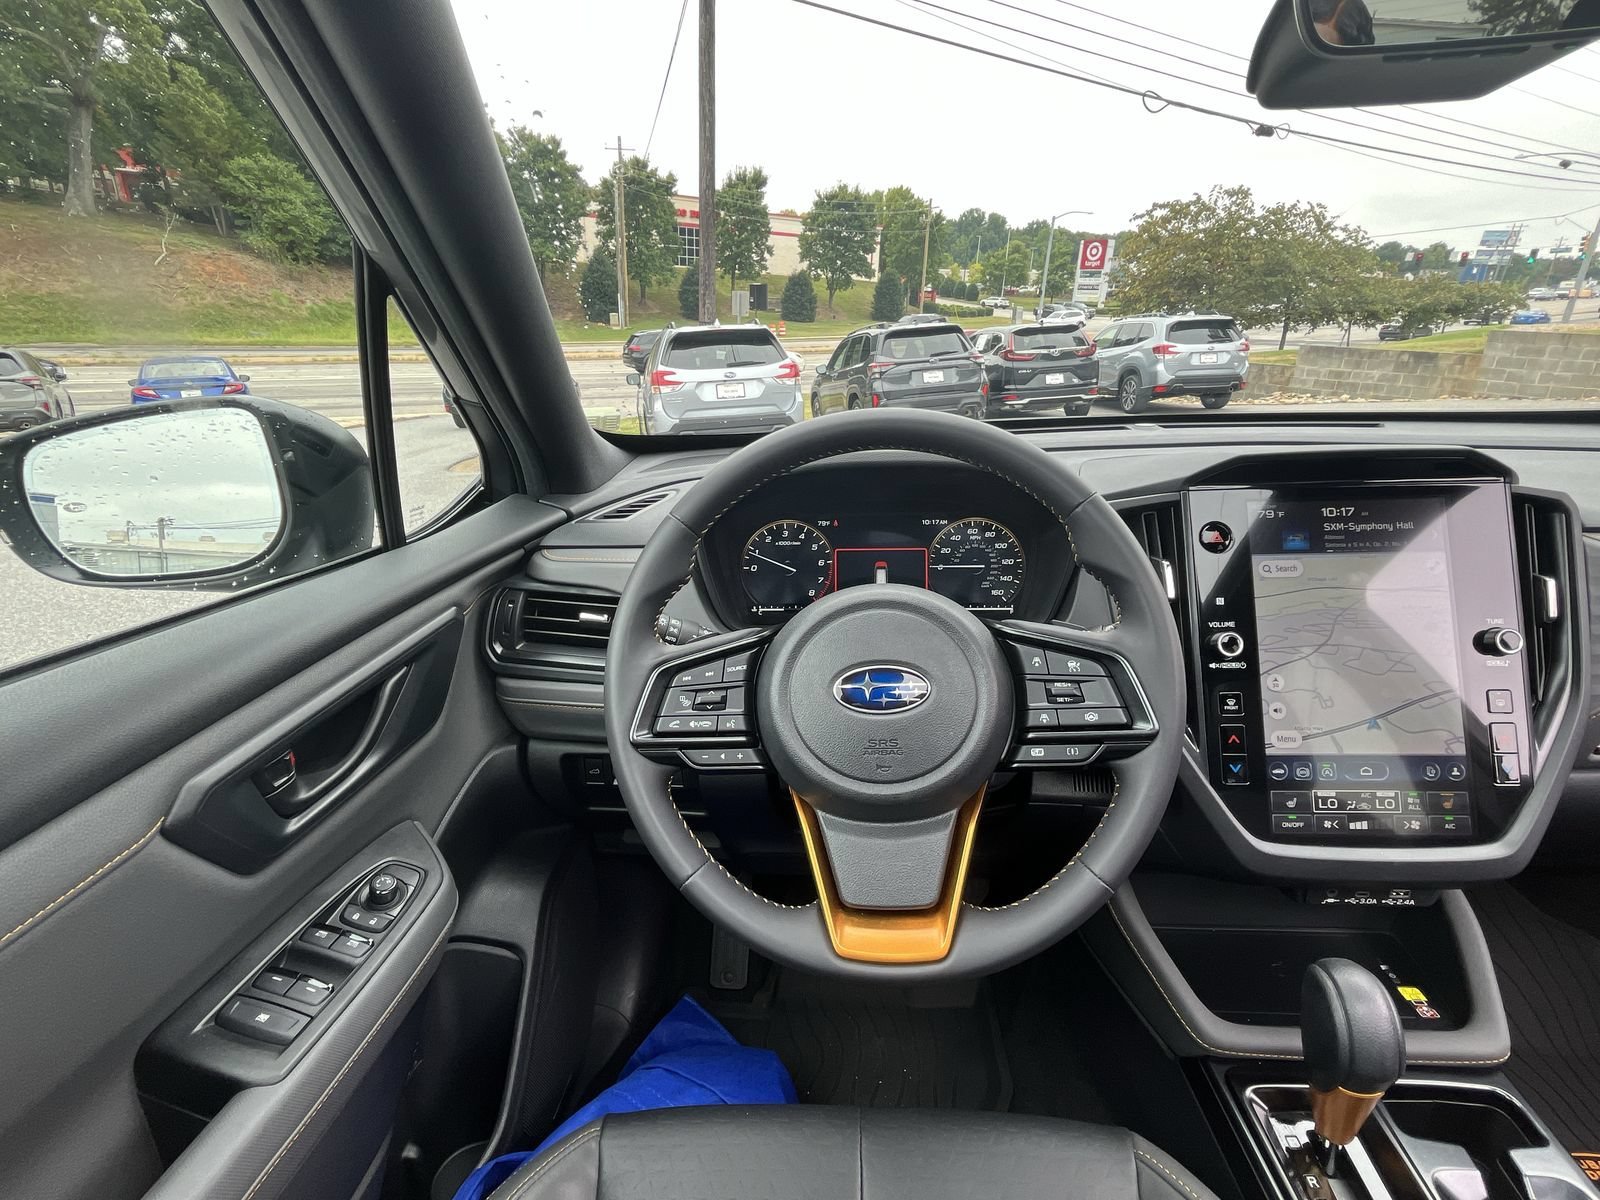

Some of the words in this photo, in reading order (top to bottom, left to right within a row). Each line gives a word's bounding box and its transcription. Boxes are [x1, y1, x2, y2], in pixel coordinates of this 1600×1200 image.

[1320, 507, 1355, 517] 10:17
[1323, 522, 1394, 532] SXM-Symphony
[1396, 521, 1415, 530] Hall
[750, 564, 758, 572] 0
[1275, 564, 1298, 573] Search
[818, 576, 824, 584] 7
[808, 589, 816, 597] 8
[726, 665, 748, 673] SOURCE
[868, 738, 899, 748] SRS
[1276, 735, 1297, 743] Menu
[1318, 798, 1338, 809] LO
[1375, 798, 1396, 809] LO
[1306, 1176, 1320, 1188] R
